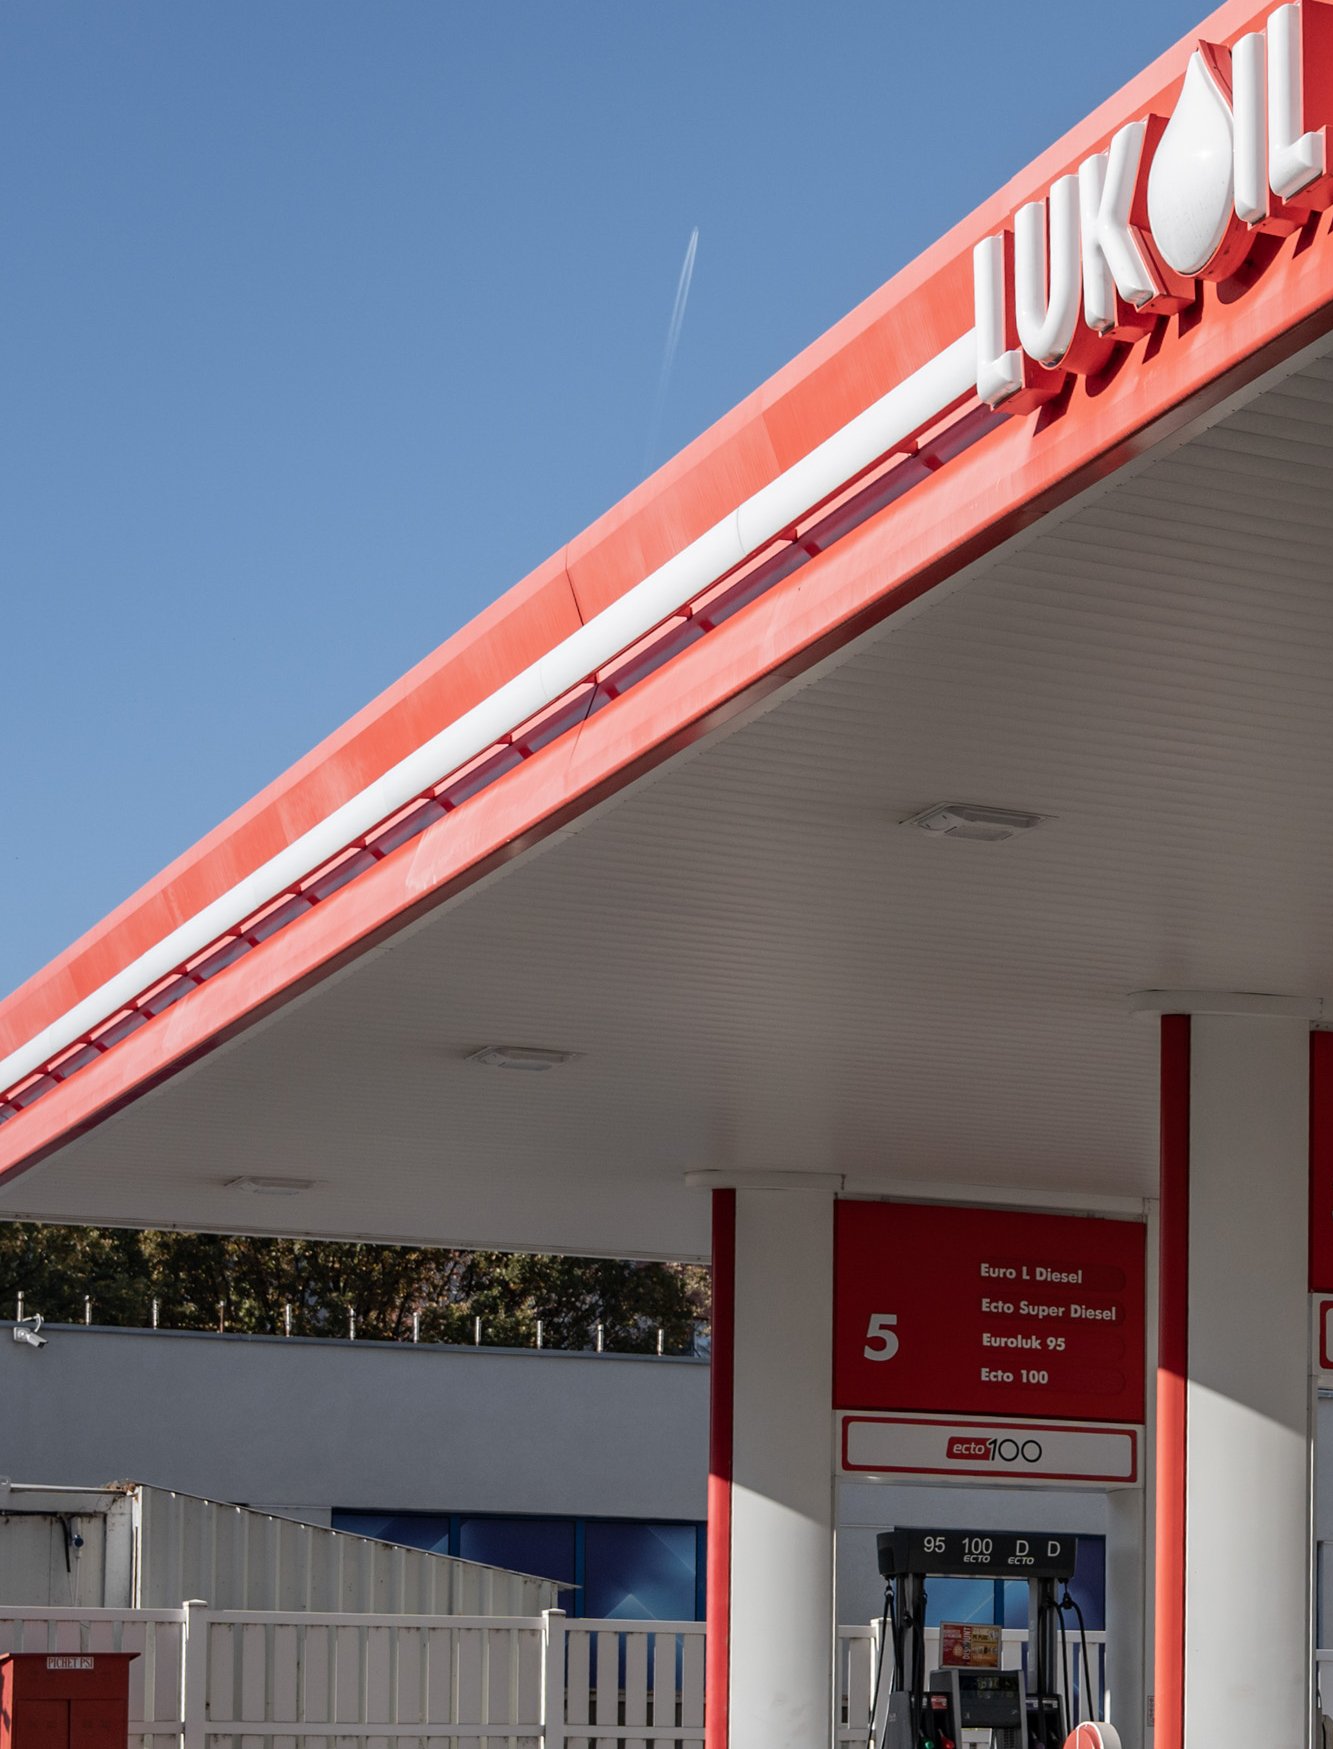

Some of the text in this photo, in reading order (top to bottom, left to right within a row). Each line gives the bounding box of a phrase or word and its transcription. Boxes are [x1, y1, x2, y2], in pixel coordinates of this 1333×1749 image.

[980, 1263, 1083, 1284] Euro L Diesel
[981, 1298, 1116, 1321] Ecto Super Diesel
[863, 1313, 899, 1361] 5
[982, 1333, 1066, 1351] Euroluk 95
[981, 1368, 1049, 1384] Ecto 100
[923, 1536, 1061, 1557] 95 100 D D
[963, 1554, 1035, 1565] ECTO ECTO
[48, 1656, 93, 1668] PICHET PSI
